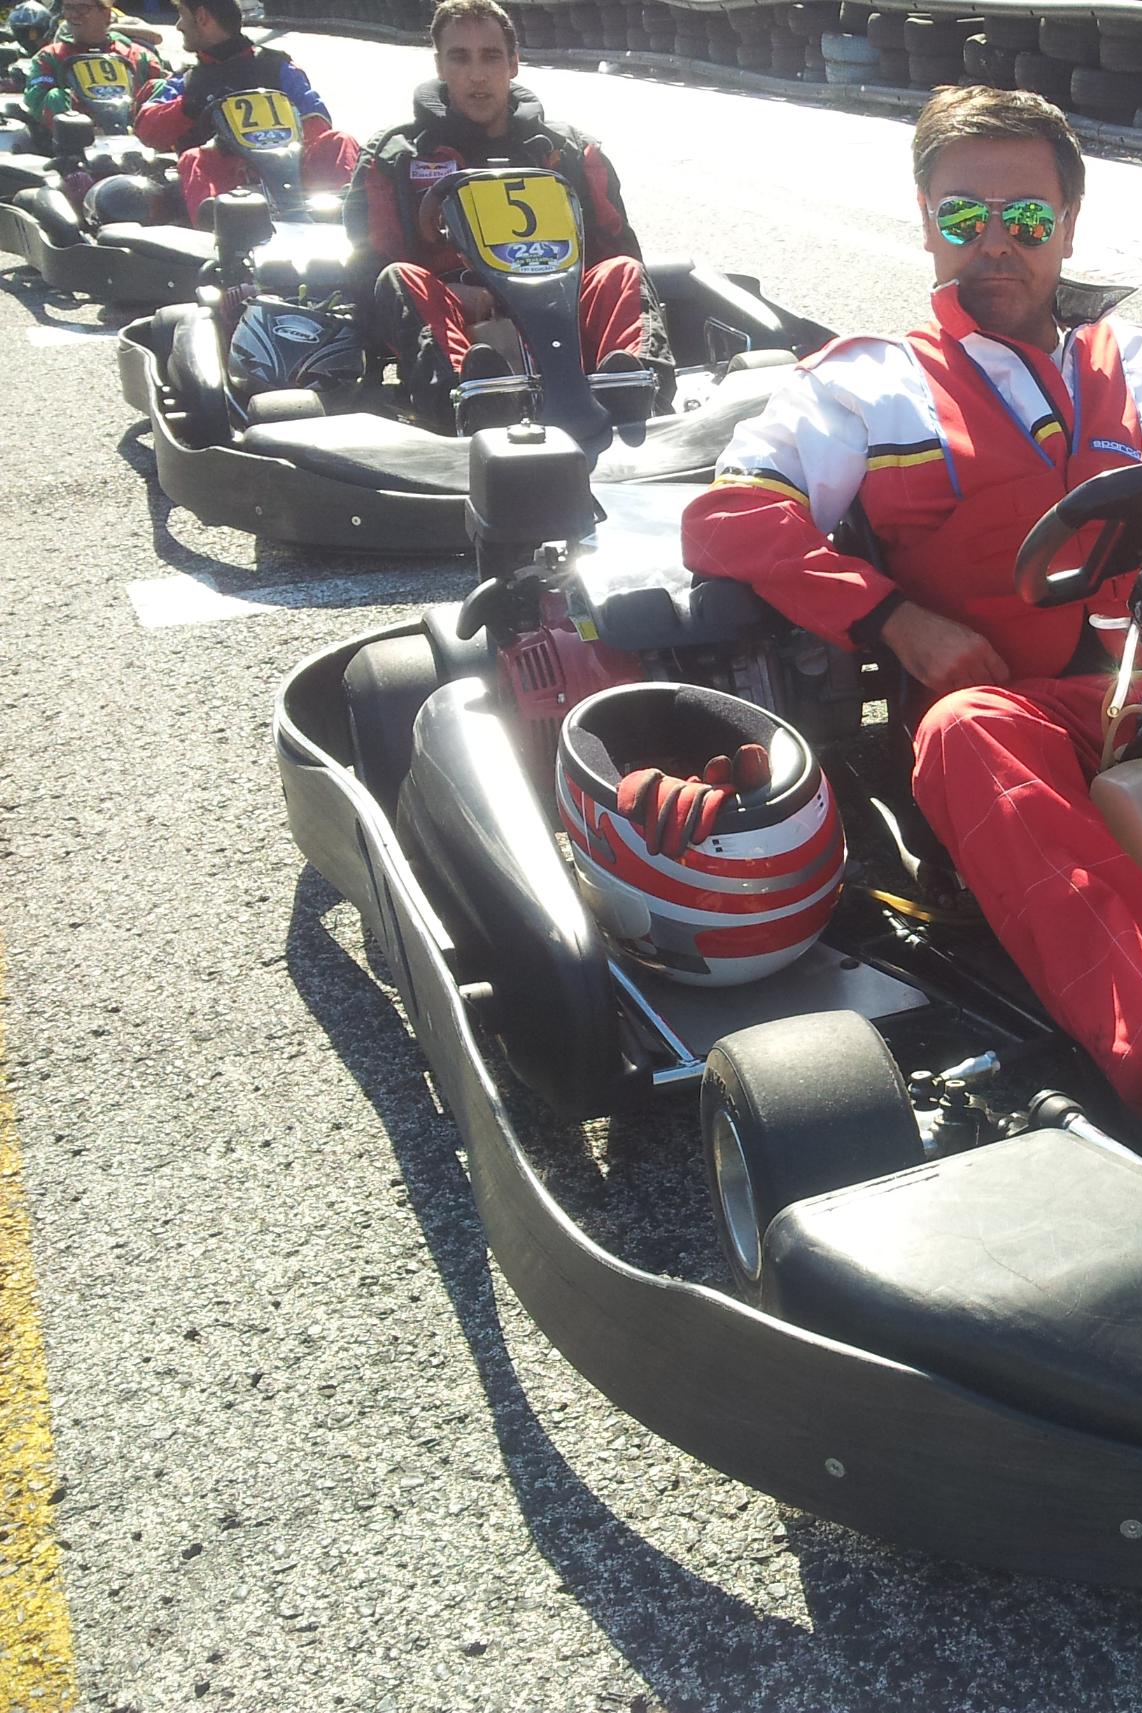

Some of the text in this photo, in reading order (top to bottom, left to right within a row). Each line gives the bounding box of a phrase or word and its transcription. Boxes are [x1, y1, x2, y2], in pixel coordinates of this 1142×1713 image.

[83, 60, 118, 84] 19
[235, 95, 284, 128] 21
[503, 179, 537, 238] 5
[512, 242, 545, 258] 24
